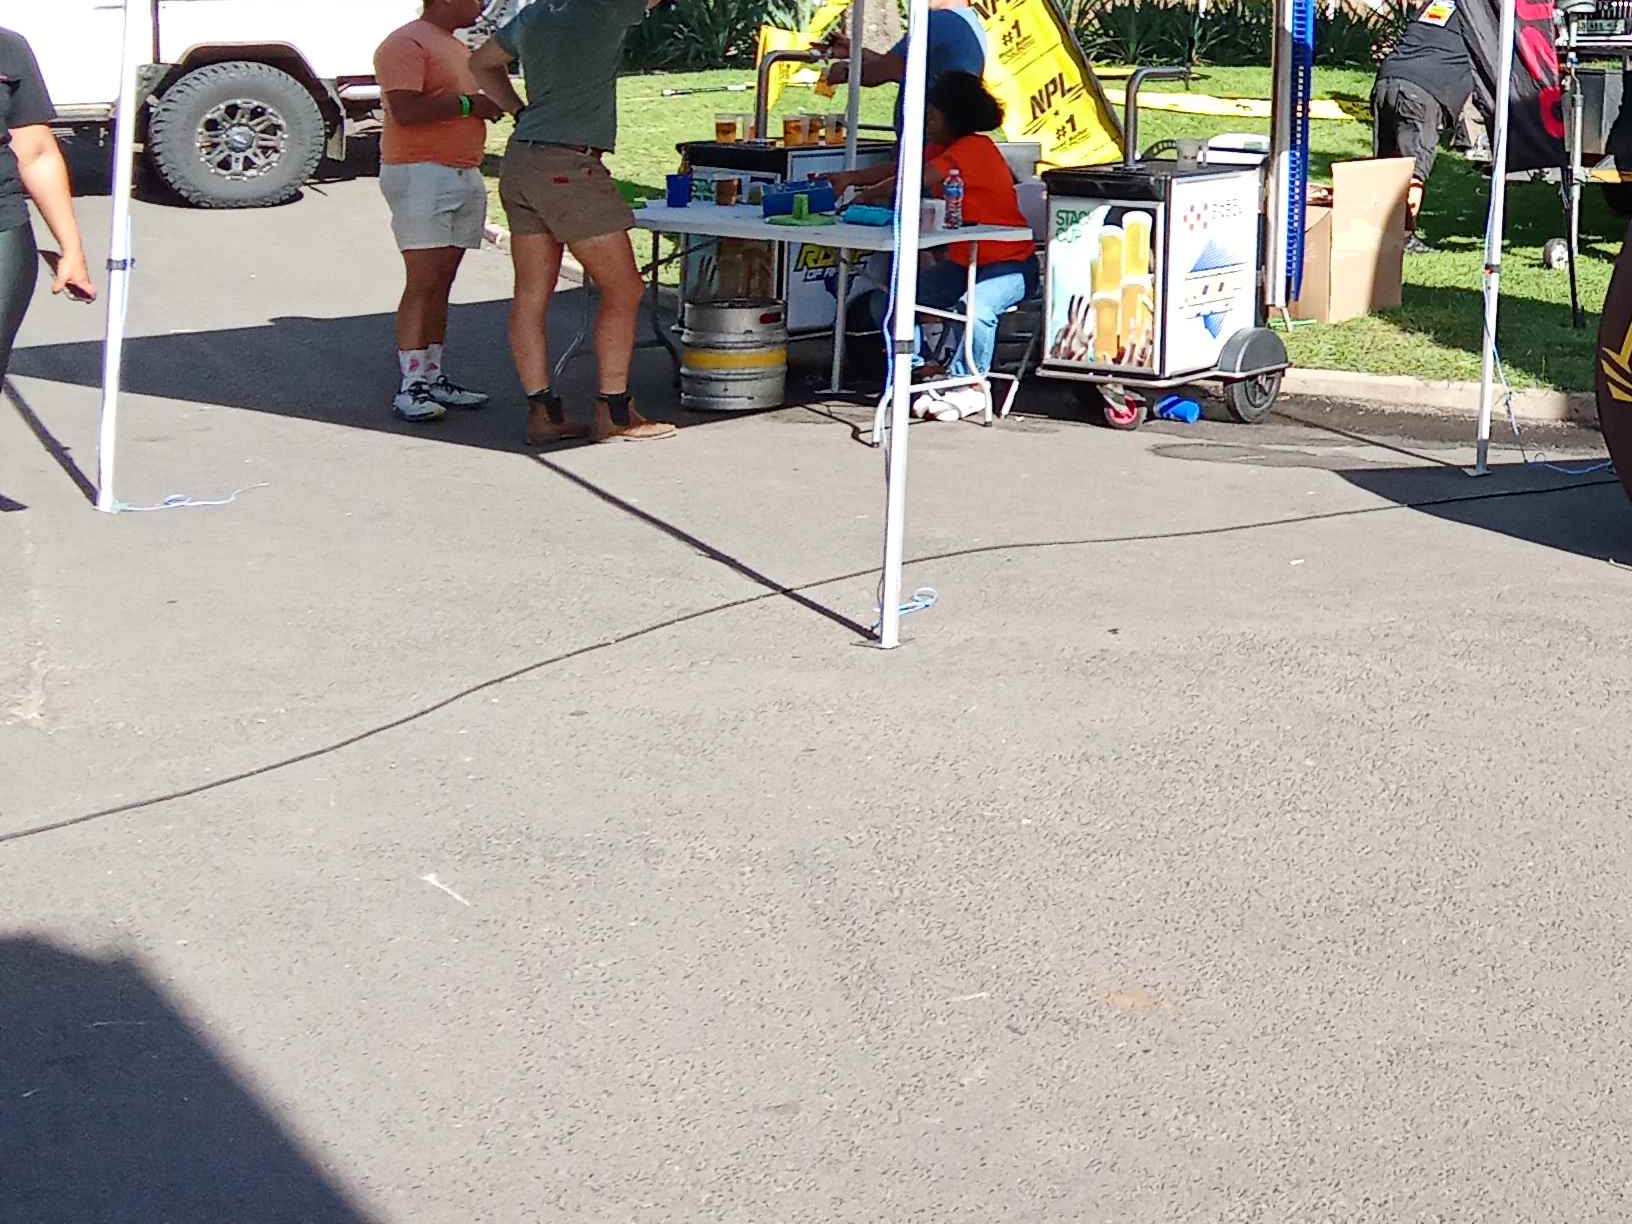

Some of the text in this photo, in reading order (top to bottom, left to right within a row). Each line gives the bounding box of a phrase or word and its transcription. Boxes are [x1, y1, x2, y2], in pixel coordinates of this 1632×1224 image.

[1002, 20, 1021, 46] #1
[1030, 72, 1080, 121] NPL
[1056, 114, 1077, 140] #1
